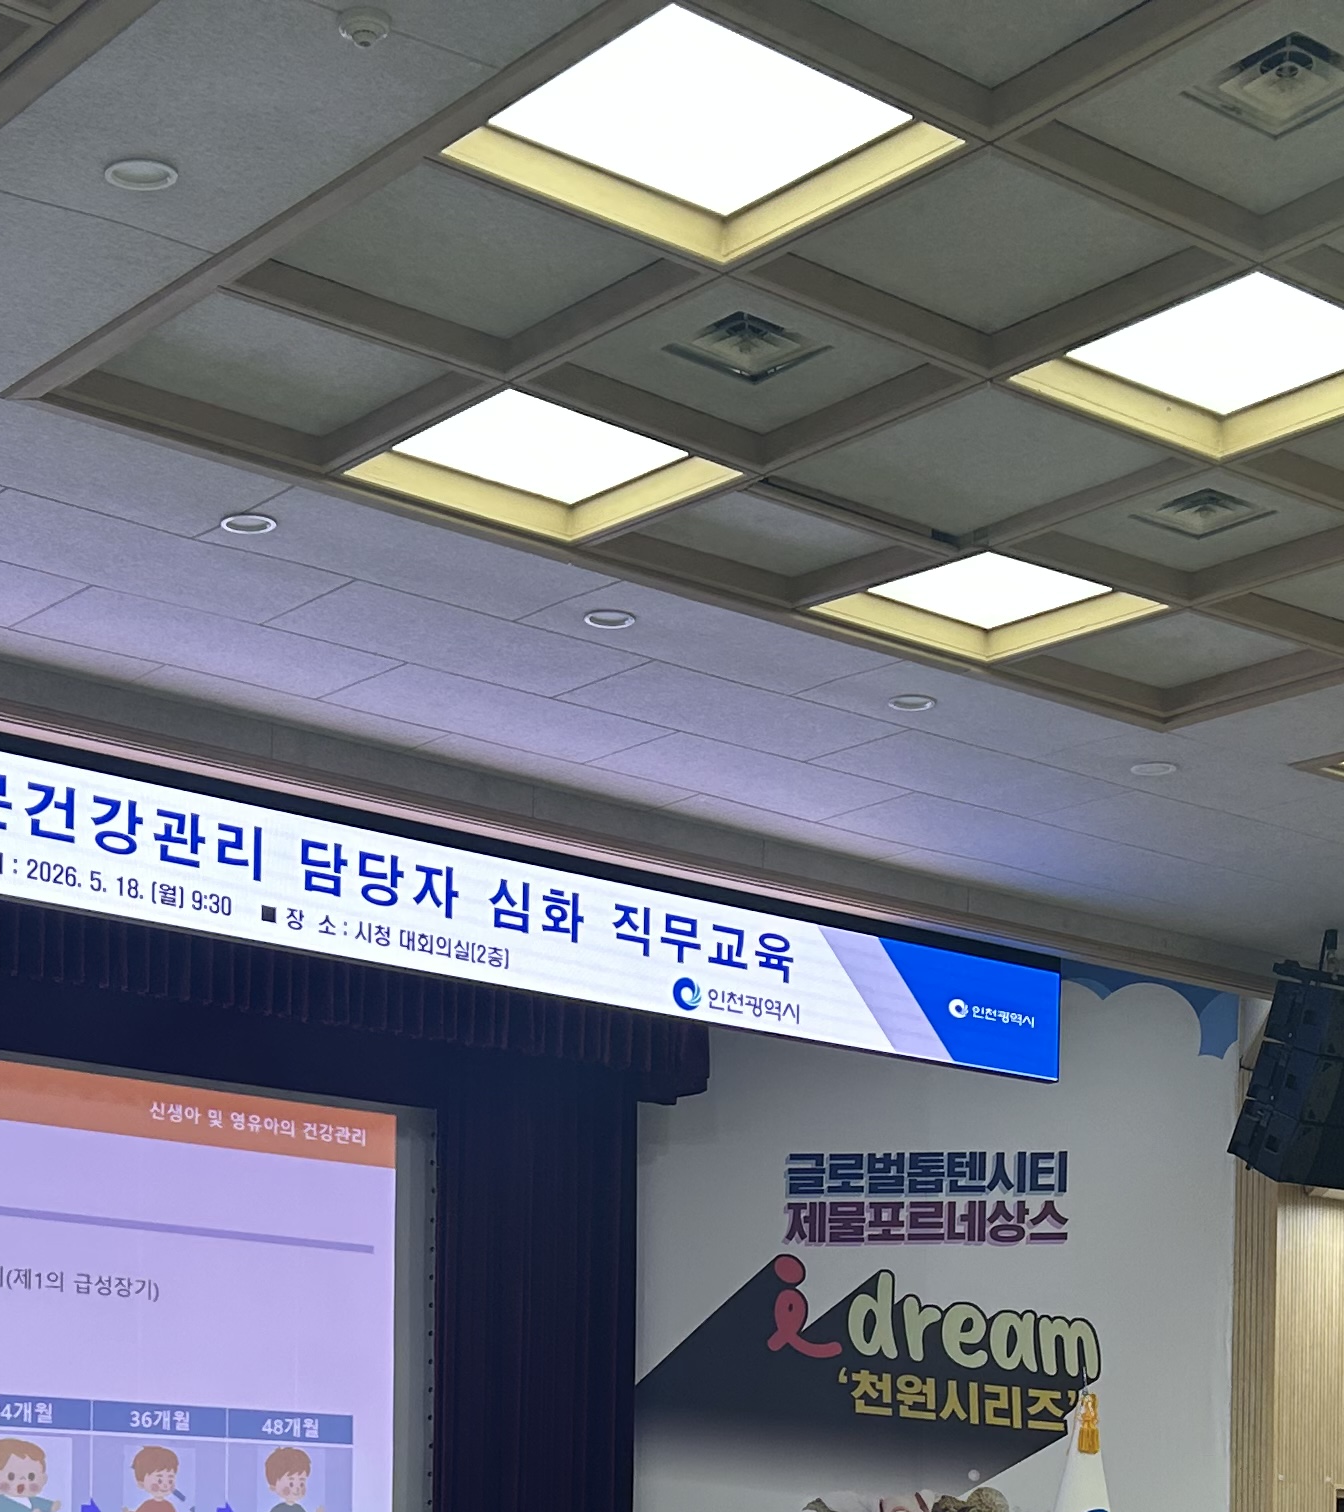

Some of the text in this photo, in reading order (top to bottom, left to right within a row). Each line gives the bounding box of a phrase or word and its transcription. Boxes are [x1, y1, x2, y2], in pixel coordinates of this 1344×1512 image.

[26, 858, 82, 888] 2026.
[89, 870, 107, 893] 5.
[116, 876, 144, 900] 18.
[191, 890, 232, 917] 9:30
[285, 907, 305, 931] 장
[355, 920, 391, 948] 시청
[299, 836, 459, 919] 담당자
[488, 877, 584, 945] 심화
[611, 902, 796, 983] 직무교육
[707, 986, 801, 1026] 인천광역시
[971, 1004, 1035, 1029] 인천광역시
[149, 1101, 368, 1148] 신생아 및 영유아의 건강관리
[784, 1150, 1069, 1198] 글로벌톱텐시티
[784, 1200, 1069, 1246] 제물포르네상스
[72, 1272, 161, 1303] 급성장기)
[767, 1253, 1102, 1382] i dream
[128, 1410, 192, 1433] 36개월
[261, 1417, 321, 1440] 48개월
